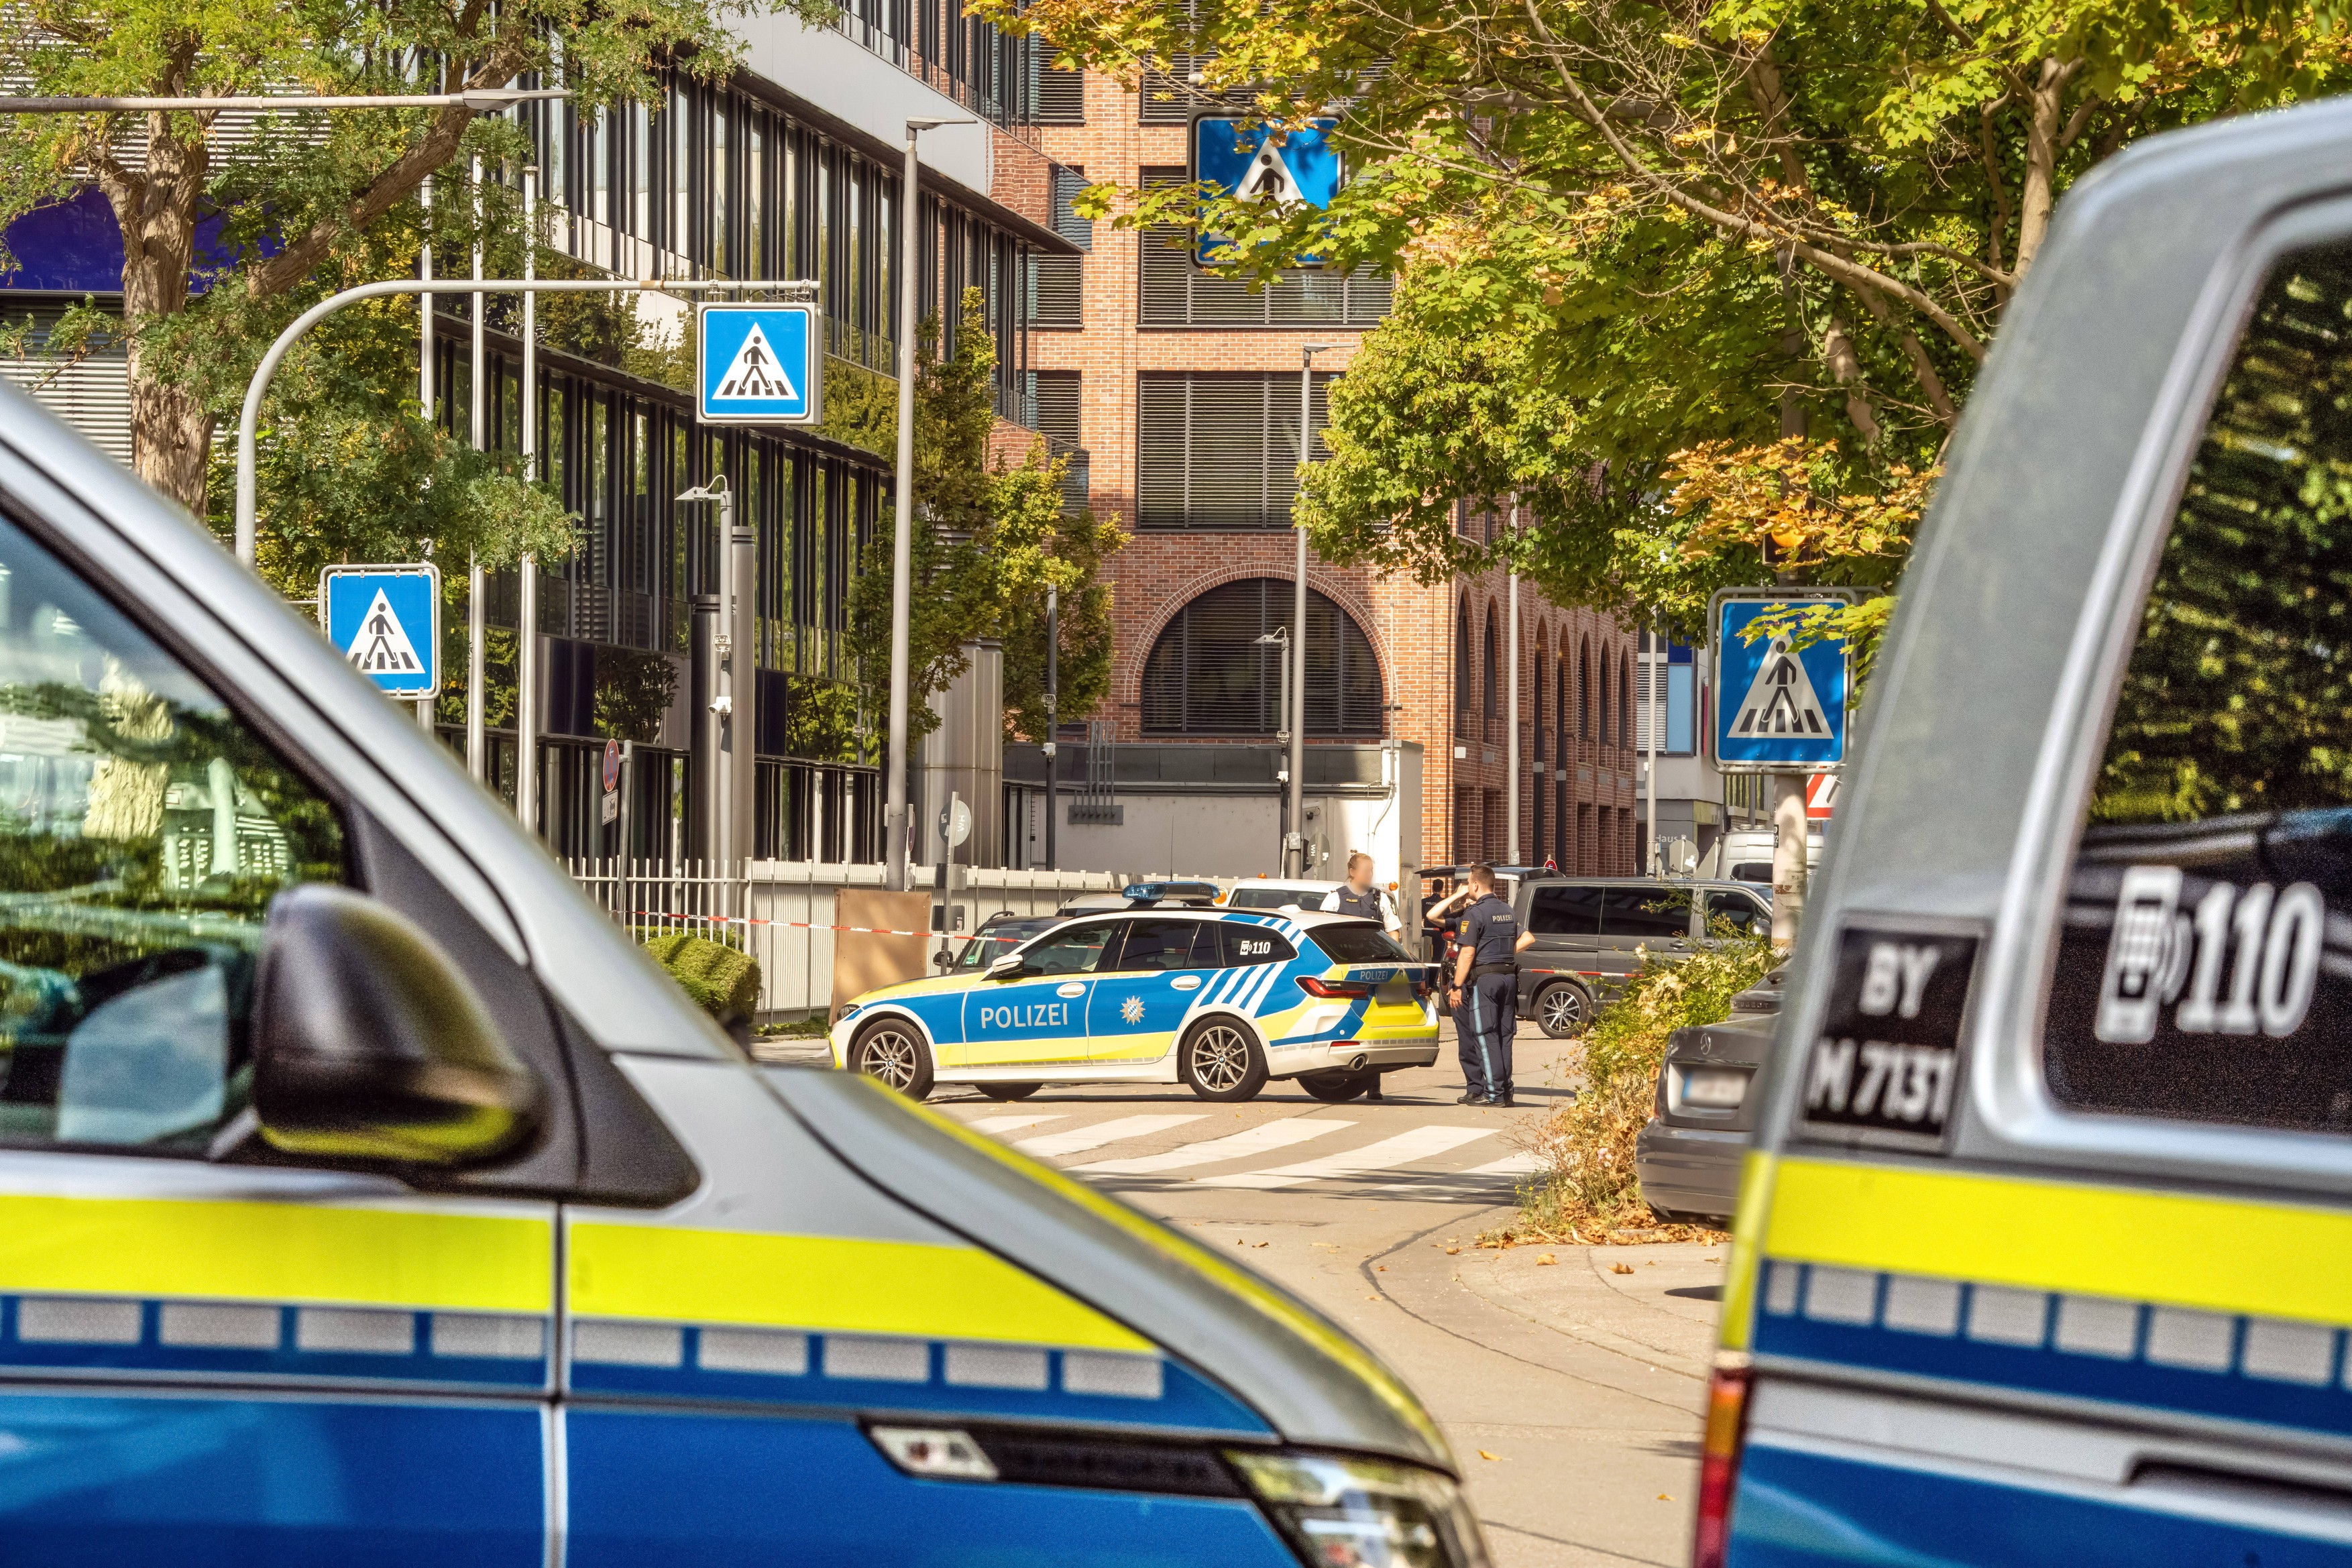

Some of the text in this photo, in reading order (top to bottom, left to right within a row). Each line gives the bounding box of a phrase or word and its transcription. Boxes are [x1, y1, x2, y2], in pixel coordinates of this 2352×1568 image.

[1310, 844, 1316, 856] WH
[1251, 942, 1271, 954] 110
[2175, 881, 2325, 1038] 110
[1360, 970, 1388, 980] POLIZEI
[1859, 942, 1941, 1019] BY
[981, 1003, 1068, 1029] POLIZEI
[1809, 1038, 1857, 1111] M
